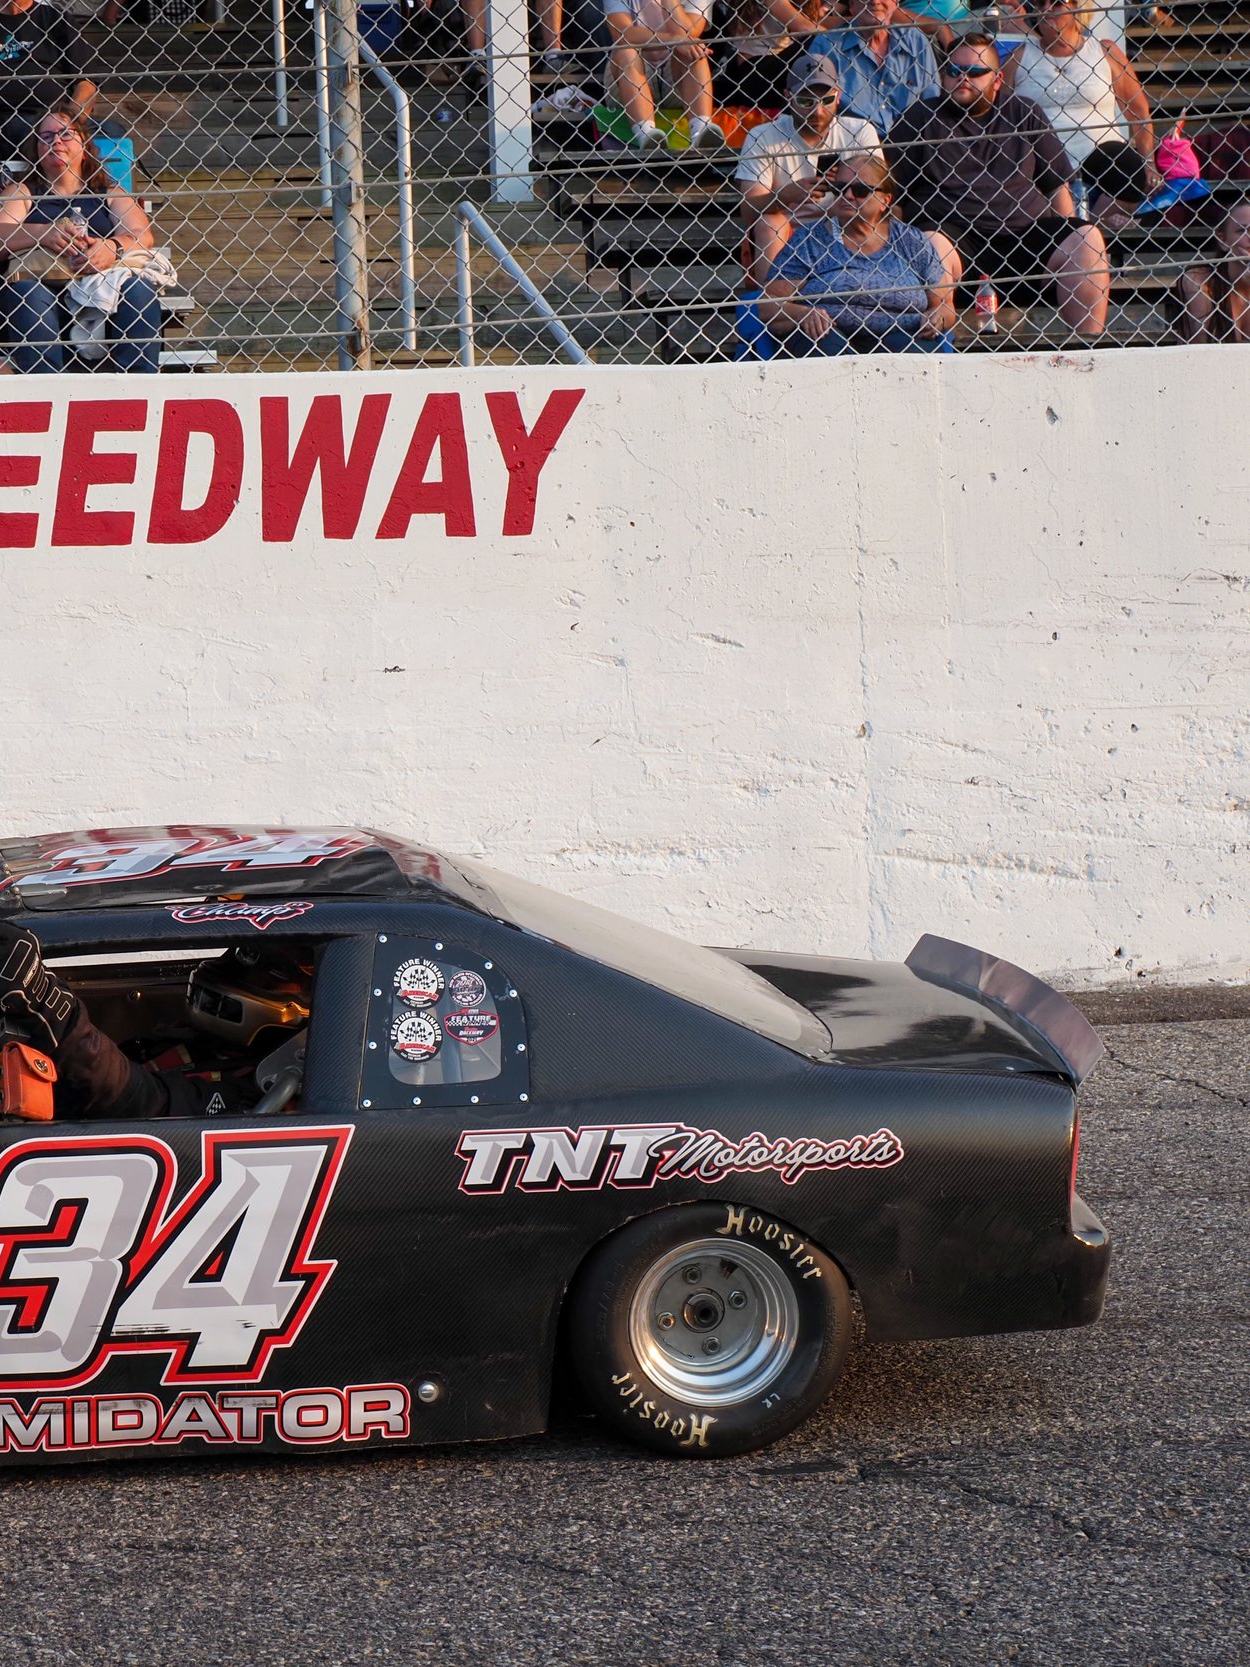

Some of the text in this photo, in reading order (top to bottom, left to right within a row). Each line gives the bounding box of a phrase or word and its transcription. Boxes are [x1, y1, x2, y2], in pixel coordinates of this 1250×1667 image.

[393, 958, 420, 987] FEATURE
[423, 959, 445, 989] WINNER
[390, 1010, 442, 1042] FEATURE WINNER
[460, 1126, 898, 1188] TNT Motorsports
[715, 1203, 822, 1280] Hoosier
[611, 1372, 719, 1447] Hoosier
